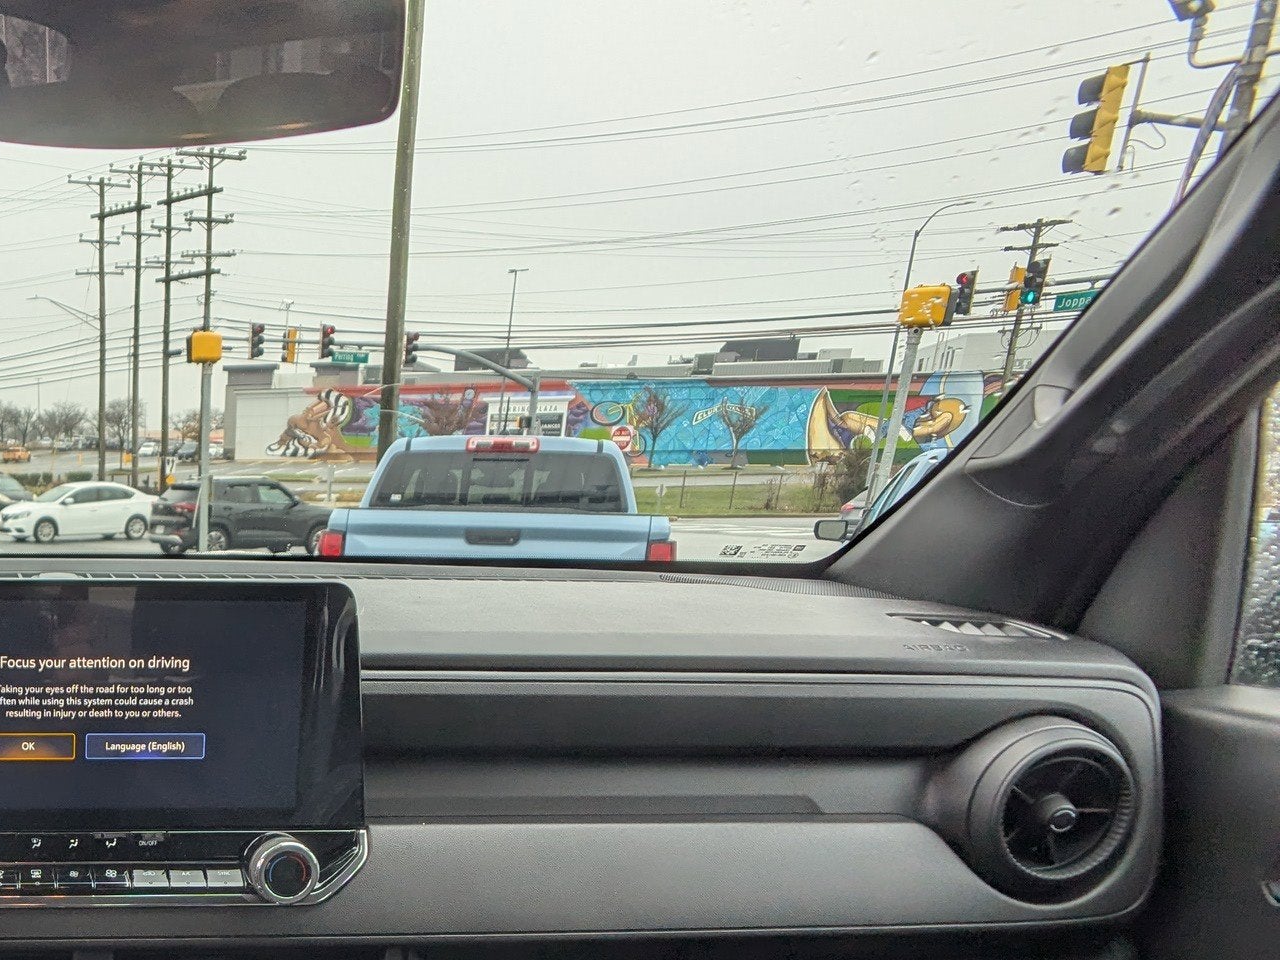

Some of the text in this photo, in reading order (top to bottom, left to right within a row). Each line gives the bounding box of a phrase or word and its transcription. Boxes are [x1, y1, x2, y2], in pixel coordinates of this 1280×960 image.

[0, 656, 190, 672] Focus your attention on driving
[25, 687, 43, 695] your
[46, 687, 64, 695] eyes
[67, 685, 79, 694] off
[80, 685, 94, 694] the
[96, 685, 114, 694] road
[117, 685, 129, 694] for
[147, 685, 165, 695] long
[18, 697, 40, 706] while
[42, 697, 64, 707] using
[66, 697, 82, 706] this
[84, 698, 112, 707] system
[114, 697, 137, 706] could
[171, 697, 194, 706] crash
[6, 709, 41, 719] resulting
[44, 710, 51, 718] in
[53, 710, 76, 719] injury
[89, 709, 112, 718] death
[125, 711, 140, 719] you
[153, 709, 182, 718] others.
[22, 742, 35, 751] OK
[105, 741, 185, 752] Language (English)
